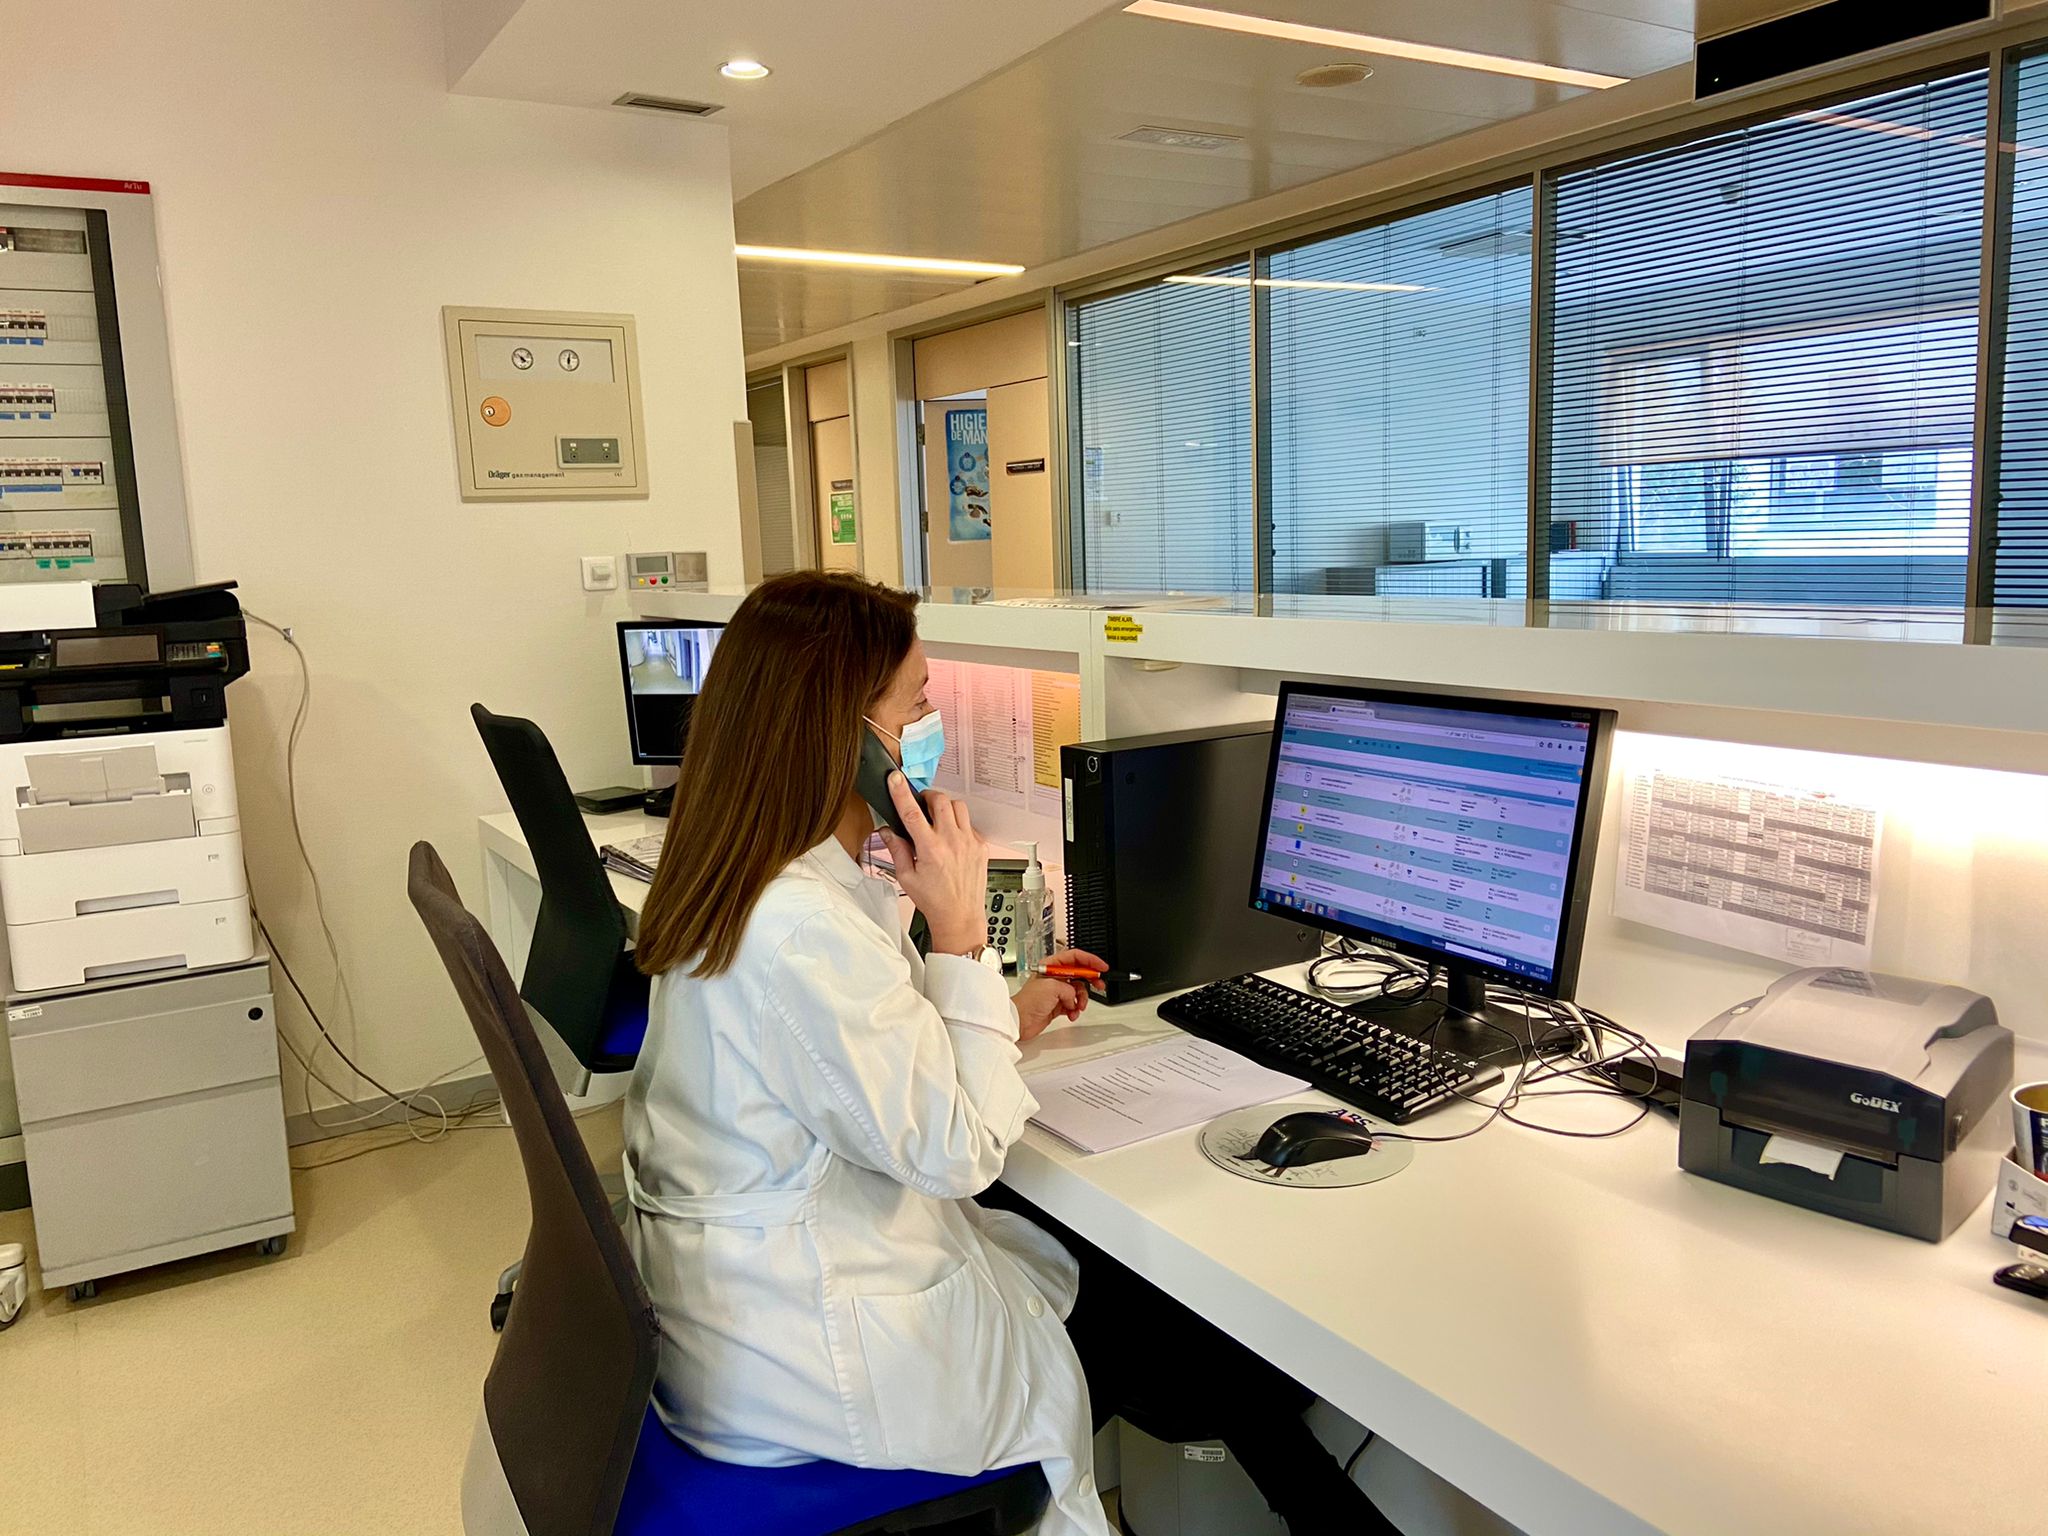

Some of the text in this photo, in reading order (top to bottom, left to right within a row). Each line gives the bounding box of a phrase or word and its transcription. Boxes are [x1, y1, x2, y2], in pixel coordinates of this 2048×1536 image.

[950, 413, 986, 430] HIGIE
[951, 430, 963, 441] DE
[488, 470, 511, 479] Dräger
[1371, 936, 1396, 949] SAMSUNG
[1850, 1092, 1903, 1113] GoDEX
